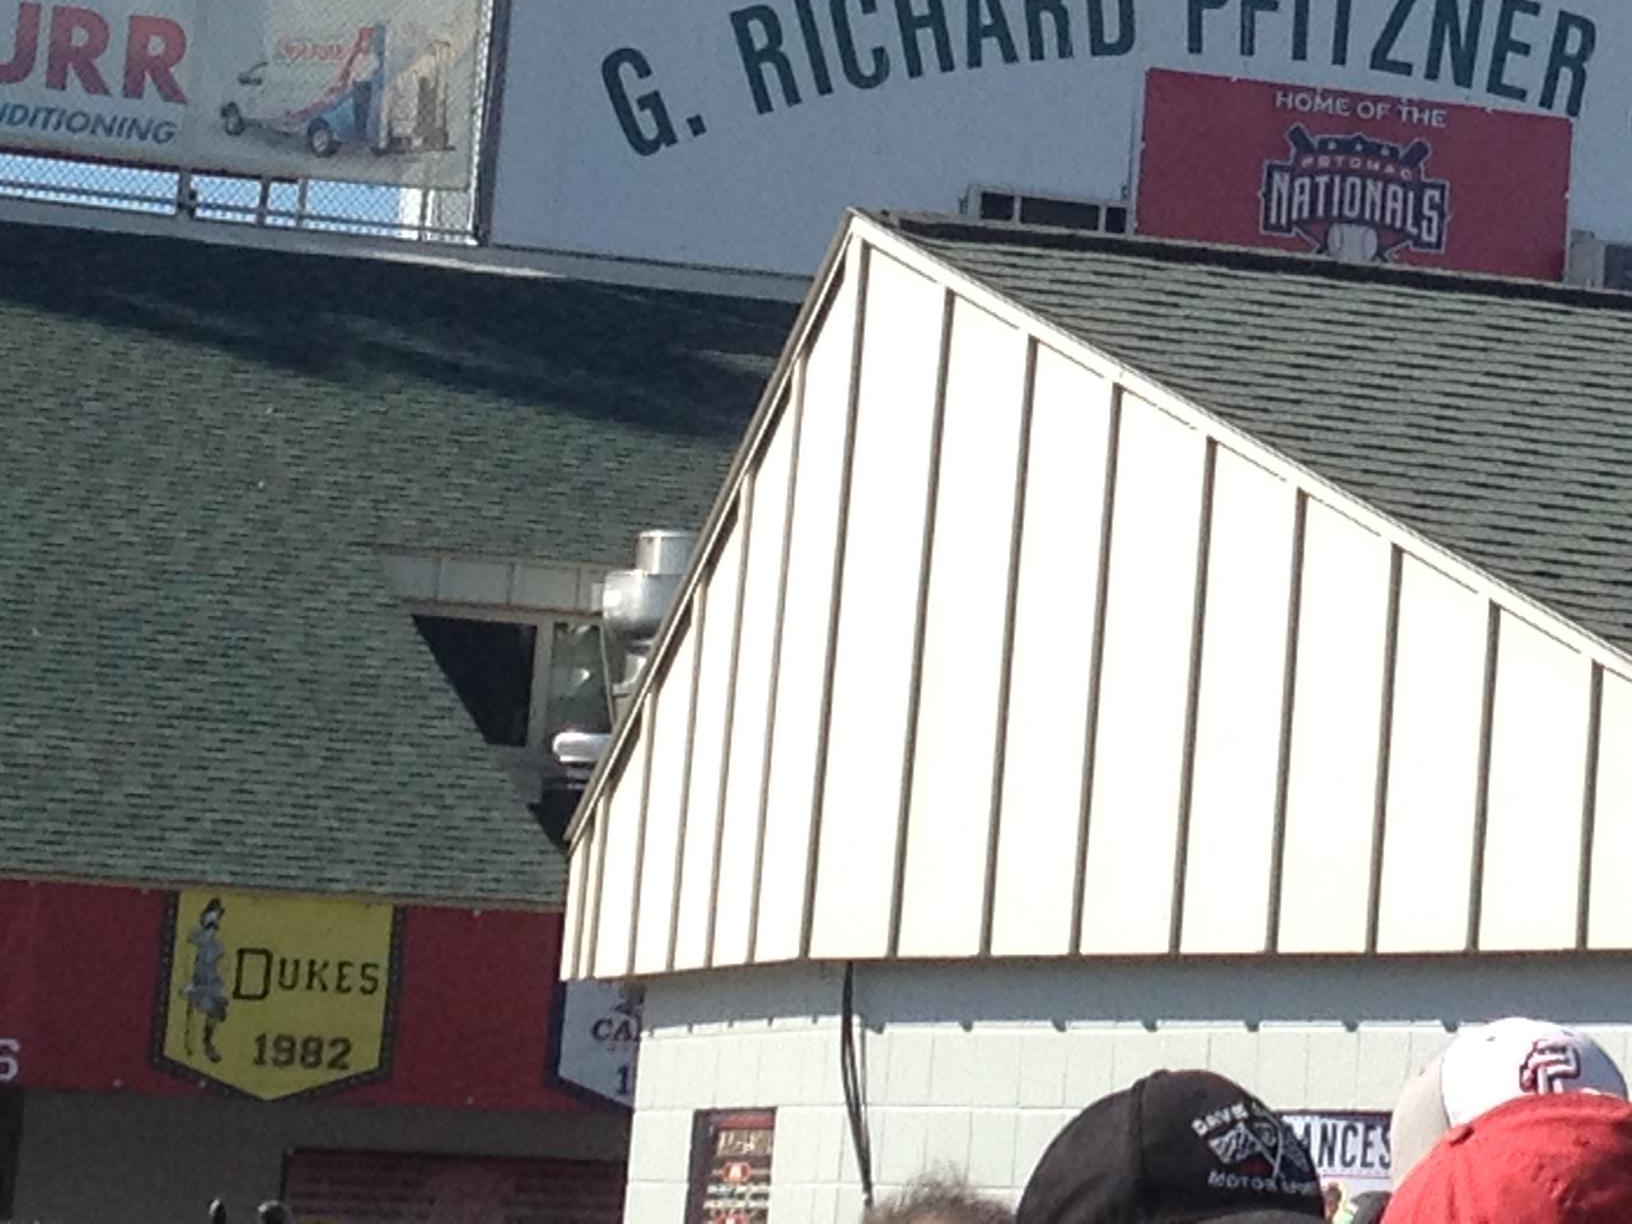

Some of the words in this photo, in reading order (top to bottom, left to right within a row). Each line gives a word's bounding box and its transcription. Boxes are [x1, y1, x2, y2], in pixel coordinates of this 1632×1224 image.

[601, 47, 706, 157] G.
[1275, 90, 1350, 117] HOME
[1357, 100, 1390, 120] OF
[1400, 103, 1447, 127] THE
[1301, 155, 1412, 180] POTOMAC
[1270, 170, 1441, 244] NATIONALS
[232, 948, 381, 1001] DUKES
[252, 1033, 353, 1071] 1982
